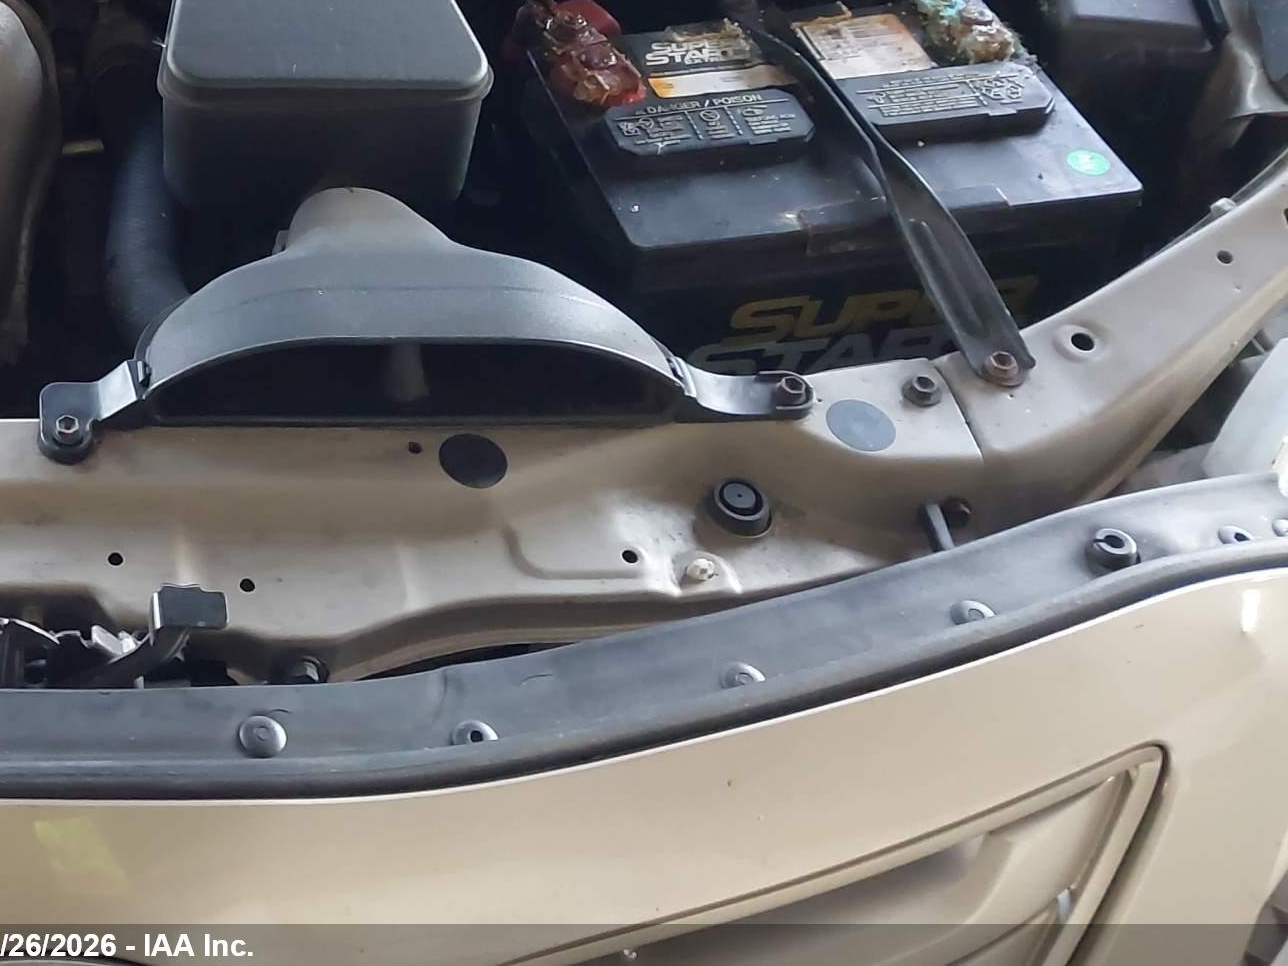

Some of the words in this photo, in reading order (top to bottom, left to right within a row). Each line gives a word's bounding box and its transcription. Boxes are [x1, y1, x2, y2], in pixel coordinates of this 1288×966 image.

[650, 41, 727, 54] SUPE
[713, 93, 763, 106] POISON
[687, 325, 956, 375] STAR
